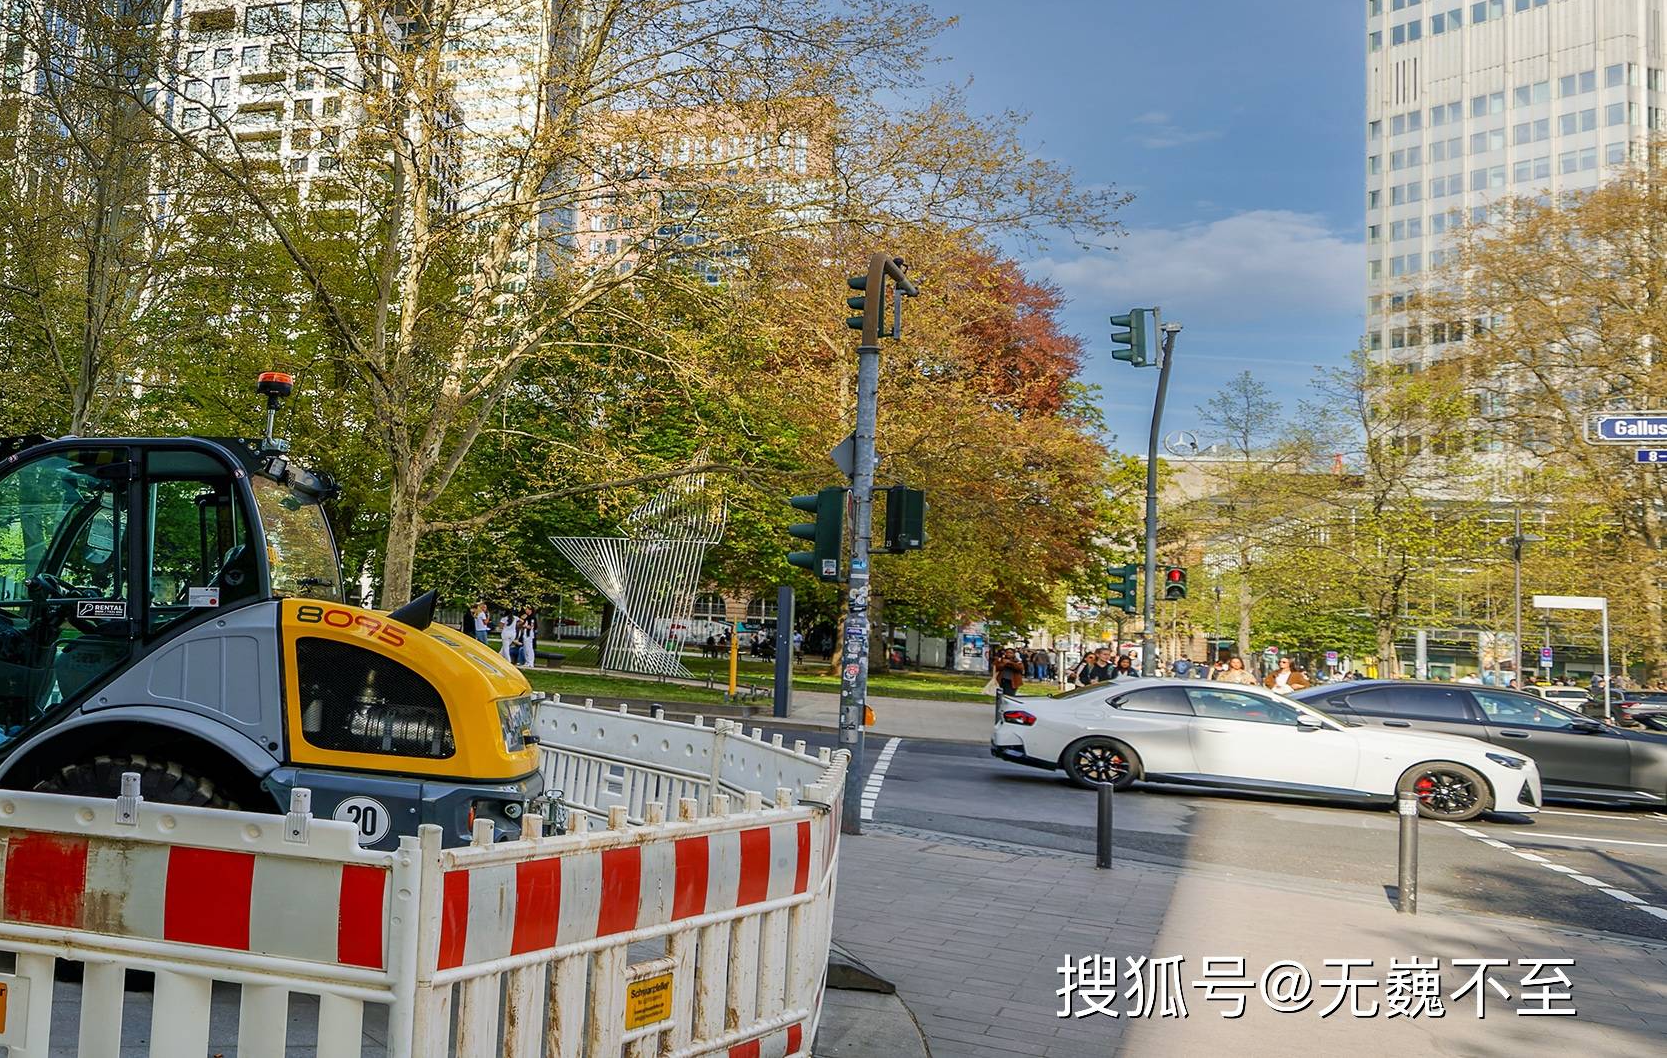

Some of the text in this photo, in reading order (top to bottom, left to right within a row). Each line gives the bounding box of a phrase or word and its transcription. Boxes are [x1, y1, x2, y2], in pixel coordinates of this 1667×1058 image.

[1615, 420, 1667, 435] Gallus
[297, 605, 407, 648] 8095
[347, 805, 377, 836] 20
